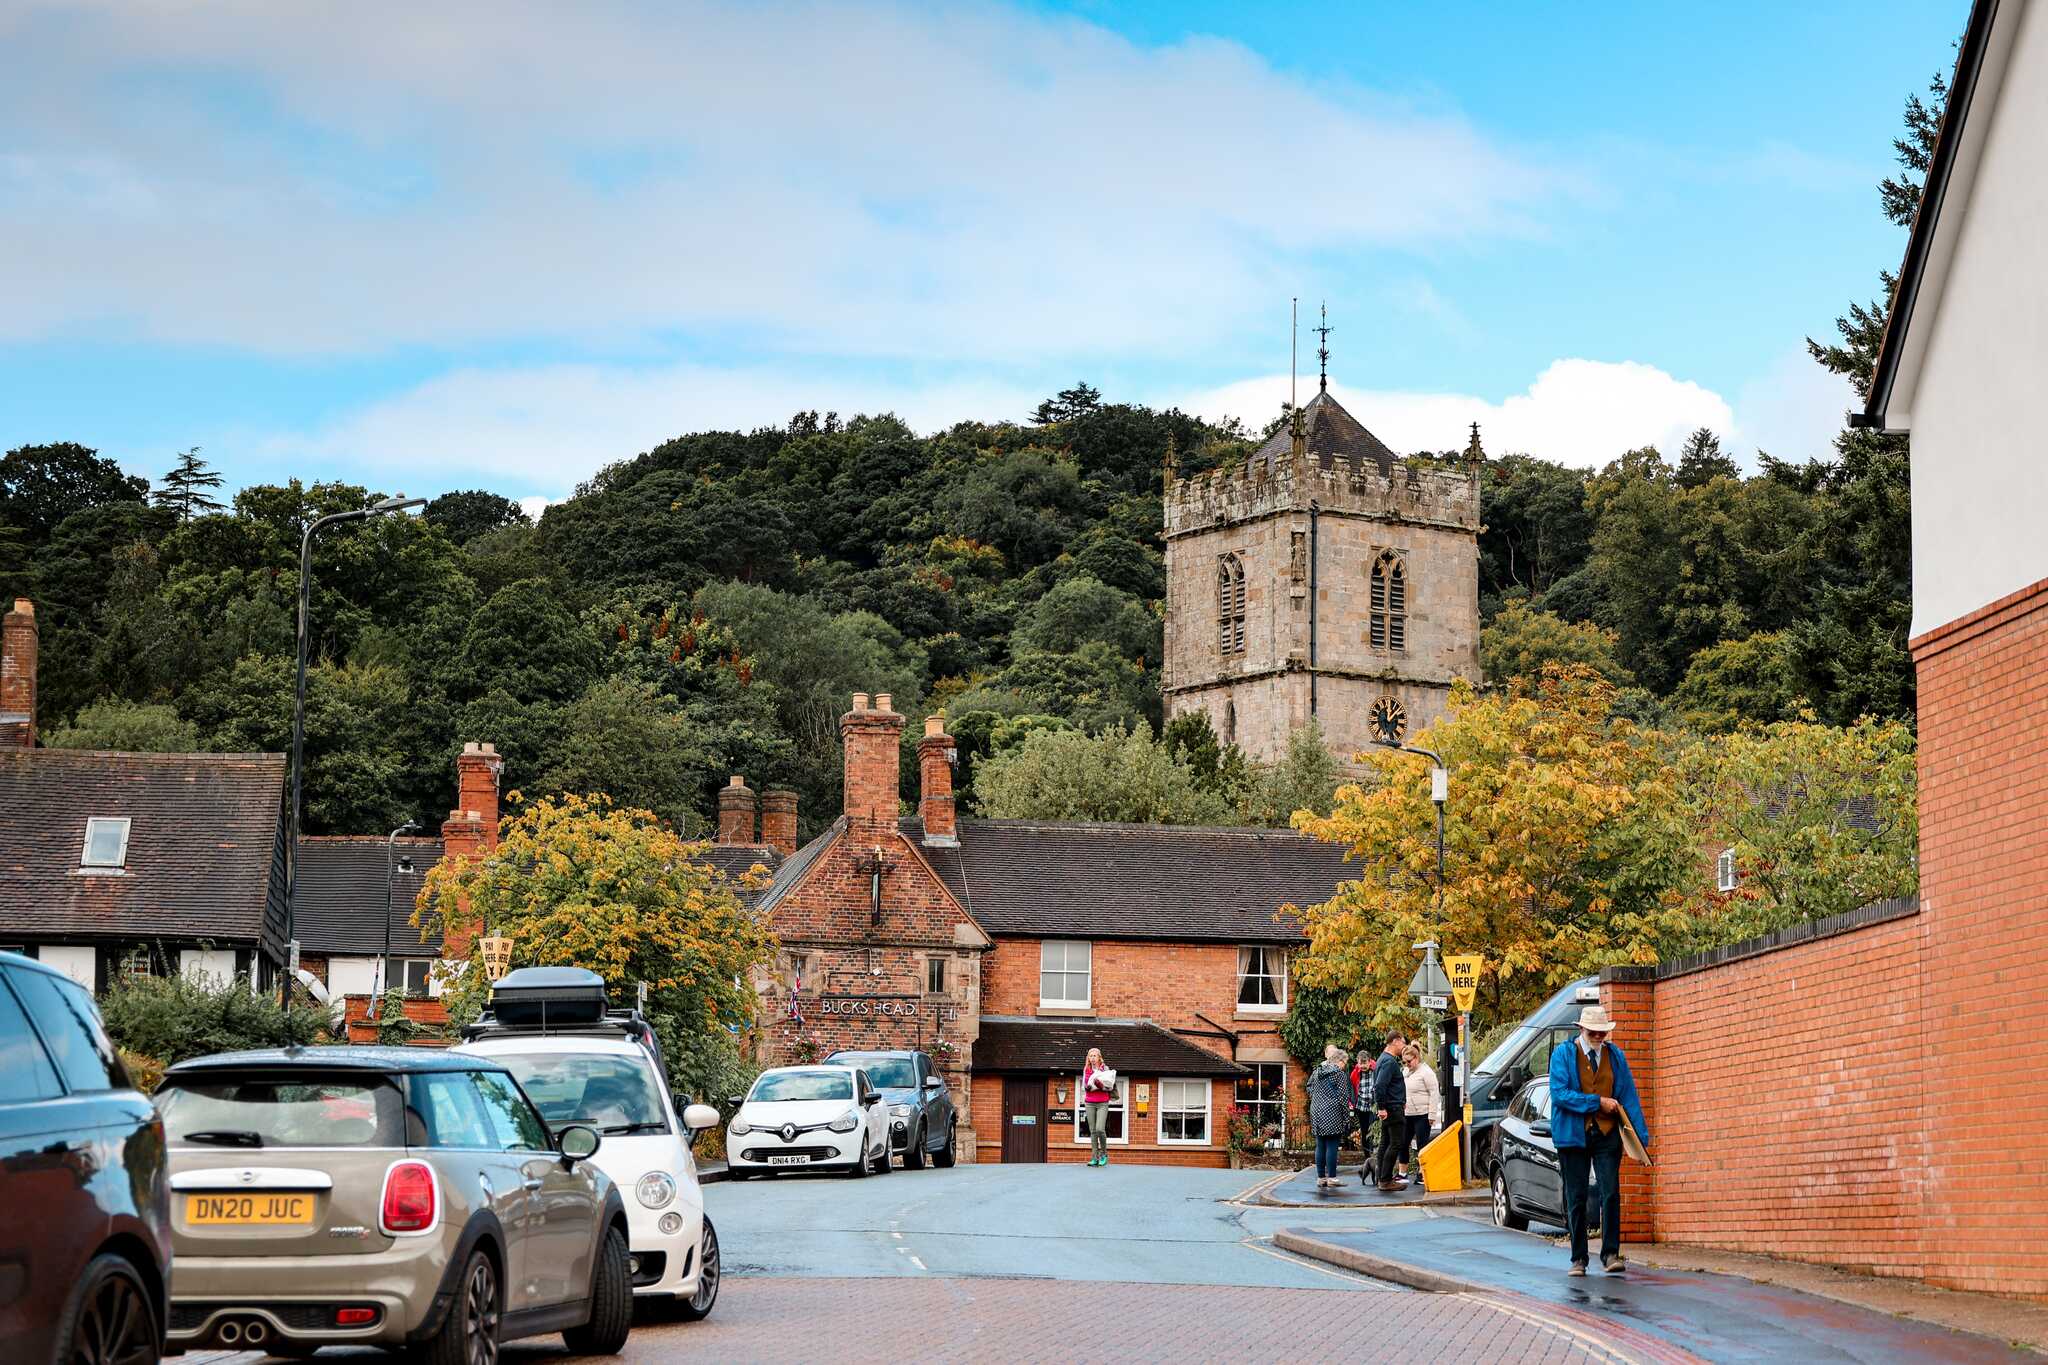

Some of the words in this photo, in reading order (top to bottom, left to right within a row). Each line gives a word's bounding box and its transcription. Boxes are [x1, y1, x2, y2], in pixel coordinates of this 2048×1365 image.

[1455, 963, 1472, 974] PAY
[1452, 977, 1476, 988] HERE
[1424, 997, 1432, 1005] 35
[822, 1001, 868, 1016] BUCKS
[873, 1003, 916, 1016] HEAD
[772, 1157, 789, 1165] DN14
[790, 1156, 806, 1164] RXG
[195, 1199, 253, 1219] DN20
[260, 1199, 303, 1218] JUC
